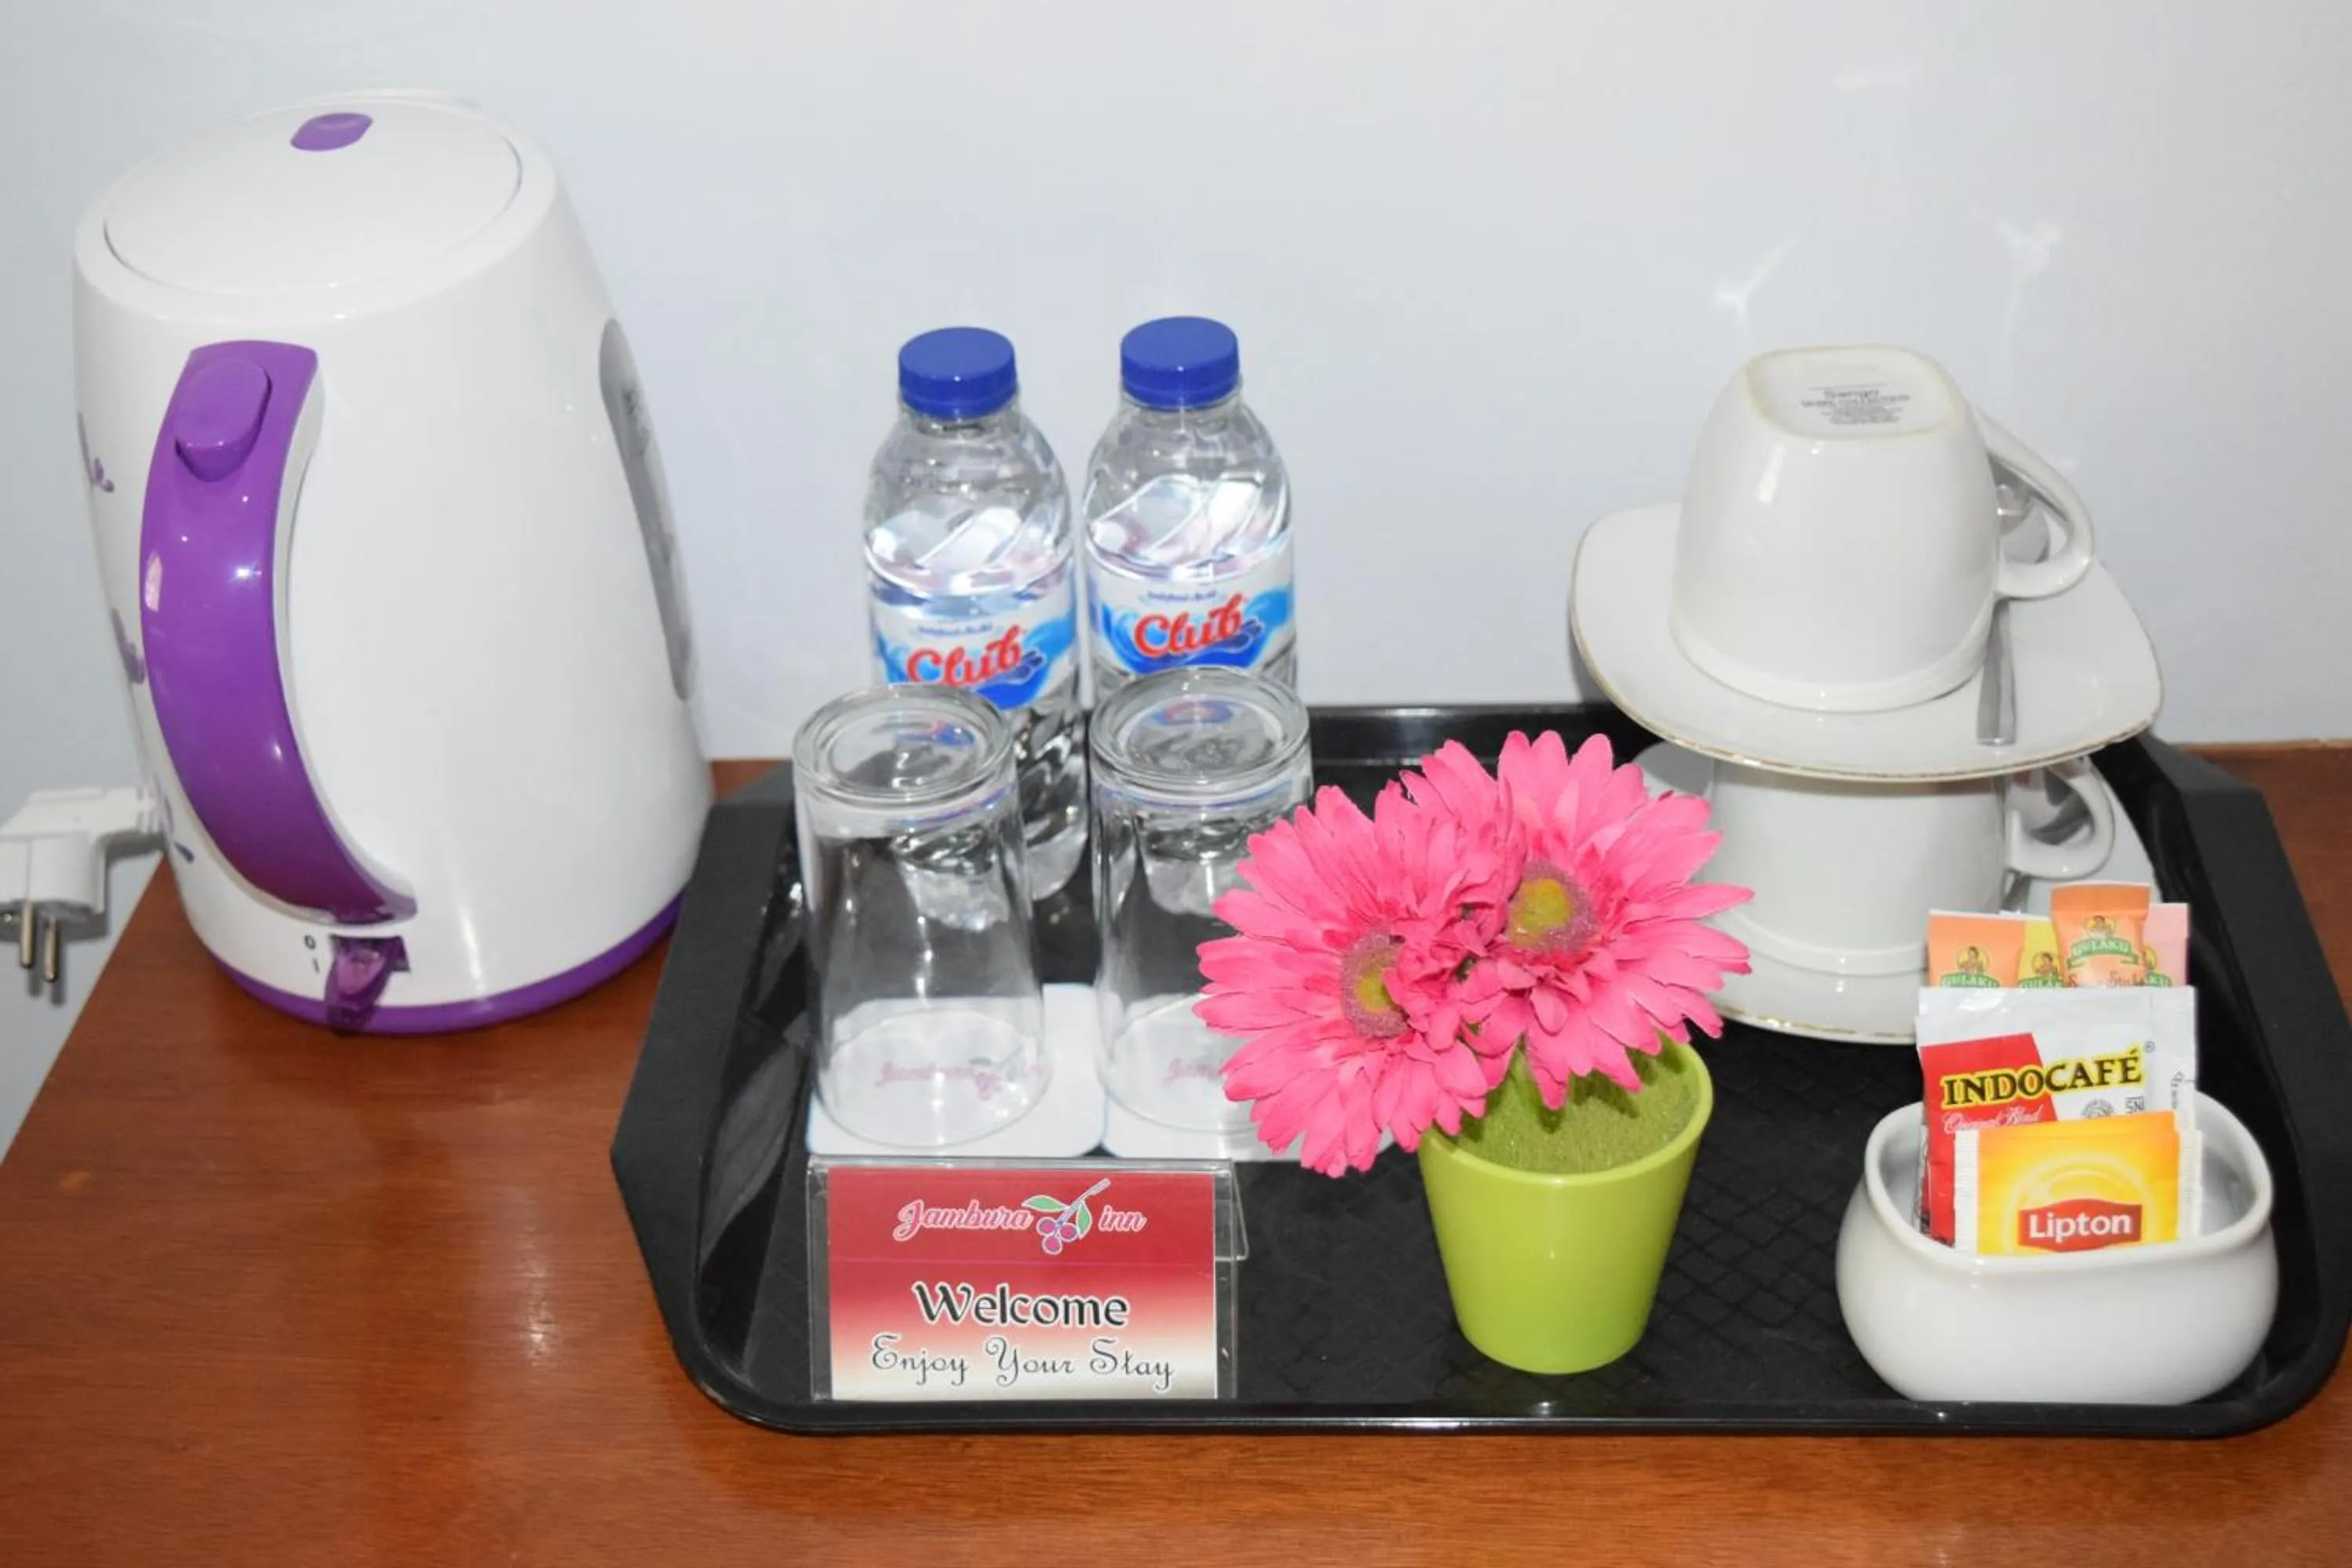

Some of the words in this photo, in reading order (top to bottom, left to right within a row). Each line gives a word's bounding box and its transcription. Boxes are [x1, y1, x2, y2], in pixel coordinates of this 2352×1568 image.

[1134, 593, 1244, 657] Club
[906, 624, 1022, 688] Club
[1943, 1046, 2143, 1106] INDOCAFÉ
[894, 1200, 1033, 1241] Jambura
[1098, 1204, 1146, 1232] inn
[2029, 1212, 2132, 1243] Lipton
[913, 1280, 1129, 1327] Welcome
[871, 1334, 970, 1386] Enjoy
[985, 1337, 1075, 1387] Your
[1089, 1338, 1174, 1391] Stay
